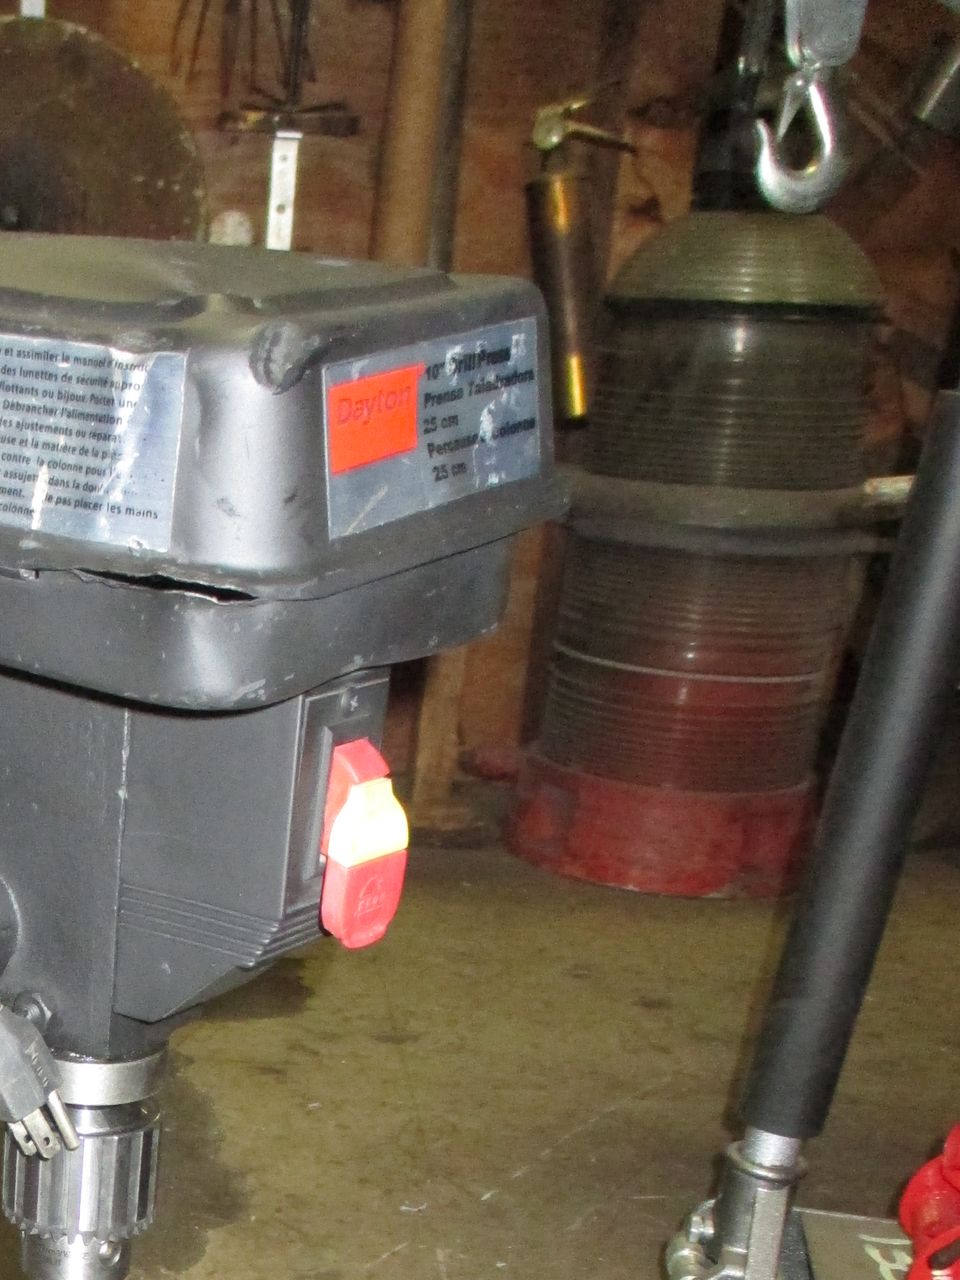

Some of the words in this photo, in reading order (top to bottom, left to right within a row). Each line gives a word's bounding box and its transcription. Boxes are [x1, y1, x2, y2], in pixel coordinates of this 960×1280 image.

[4, 346, 13, 356] et
[1, 364, 16, 376] des
[19, 366, 58, 381] lunettes
[61, 372, 72, 383] de
[41, 388, 54, 398] ou
[2, 399, 58, 417] Débrancher
[60, 407, 123, 426] l'alimentation
[336, 385, 411, 427] Dayton
[15, 418, 72, 437] ajustements
[75, 429, 86, 438] ou
[423, 415, 438, 434] 25
[442, 413, 459, 430] cm
[18, 436, 28, 446] et
[31, 437, 39, 447] la
[78, 445, 89, 456] de
[91, 446, 99, 457] la
[1, 450, 31, 464] contre
[47, 458, 82, 473] colonne
[85, 465, 106, 478] pour
[432, 464, 450, 484] 25
[451, 461, 468, 479] cm
[3, 468, 42, 485] assujet
[48, 476, 72, 488] dans
[72, 478, 81, 489] la
[55, 496, 71, 508] pas
[74, 498, 103, 512] placer
[106, 501, 121, 513] les
[125, 504, 158, 519] mains
